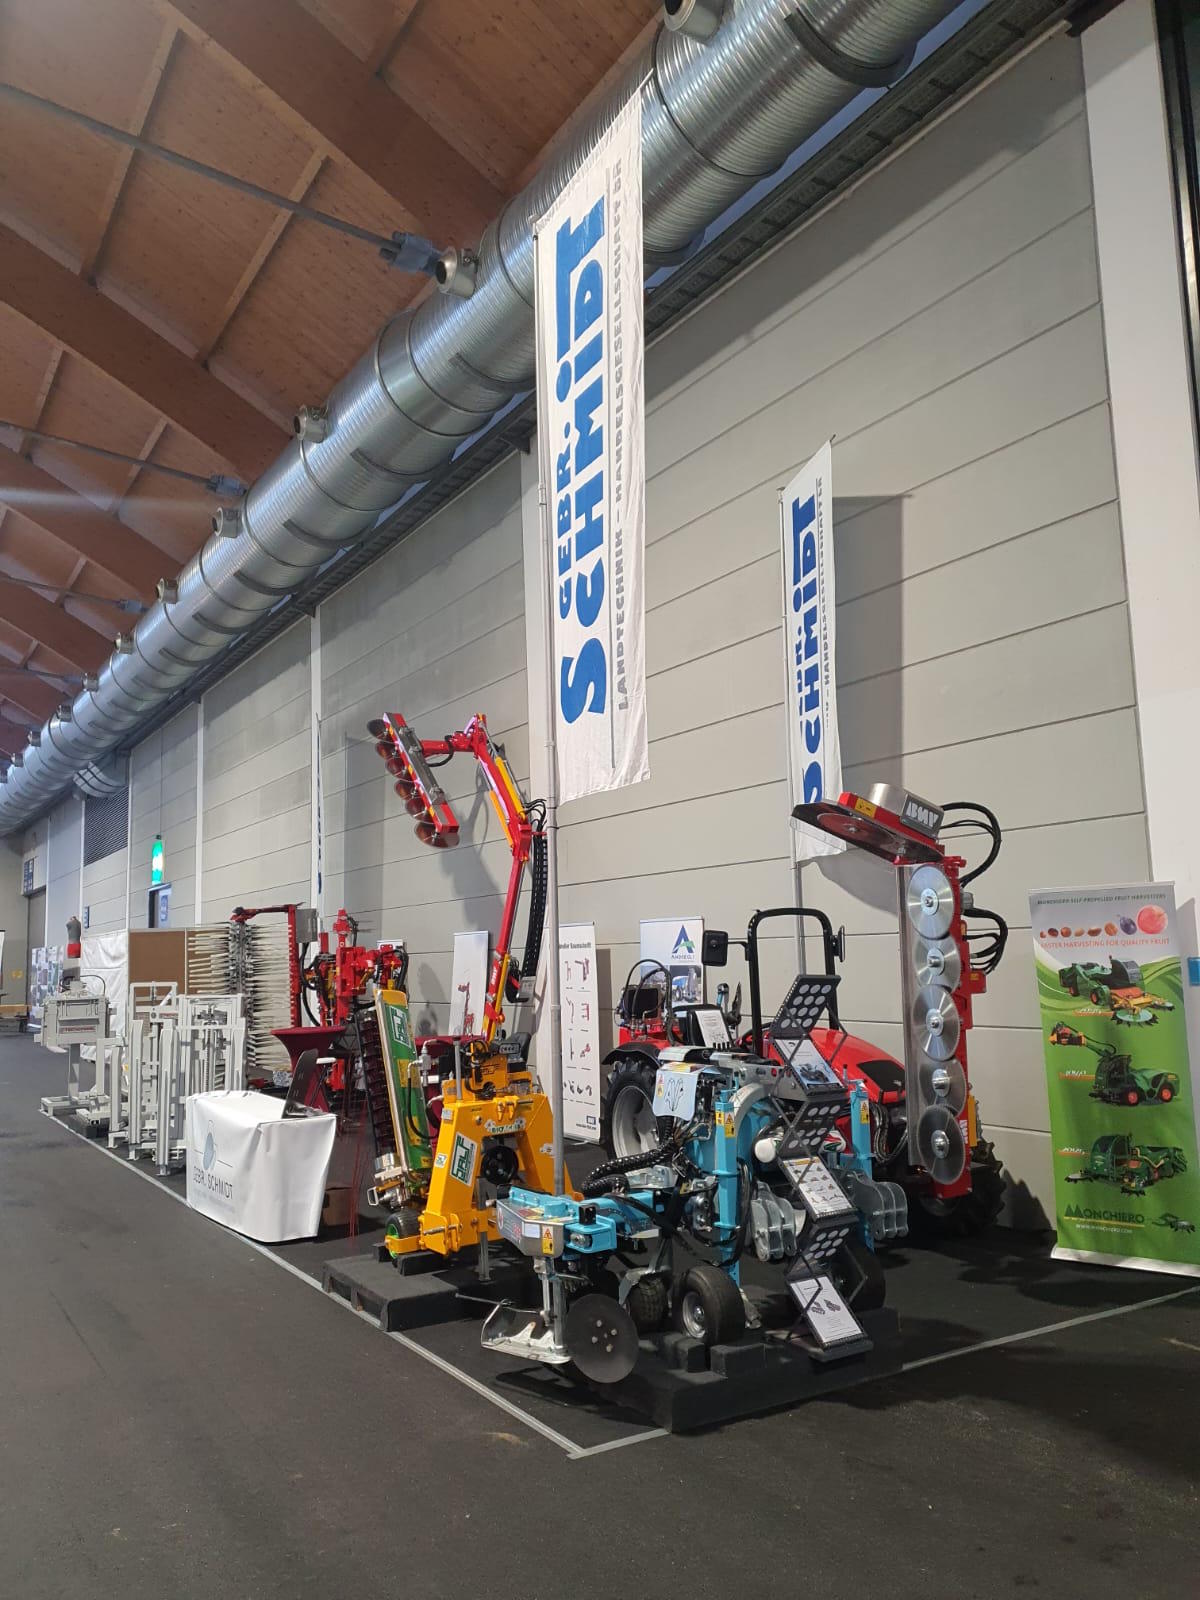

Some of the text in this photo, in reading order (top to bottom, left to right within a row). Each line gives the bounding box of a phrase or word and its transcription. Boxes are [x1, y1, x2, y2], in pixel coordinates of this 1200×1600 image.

[613, 200, 625, 503] HANDELSGESELLSCHAFT
[556, 422, 573, 620] GEBR.
[614, 527, 628, 711] LANDTECHNIK
[1064, 1203, 1145, 1224] MONCHIERO
